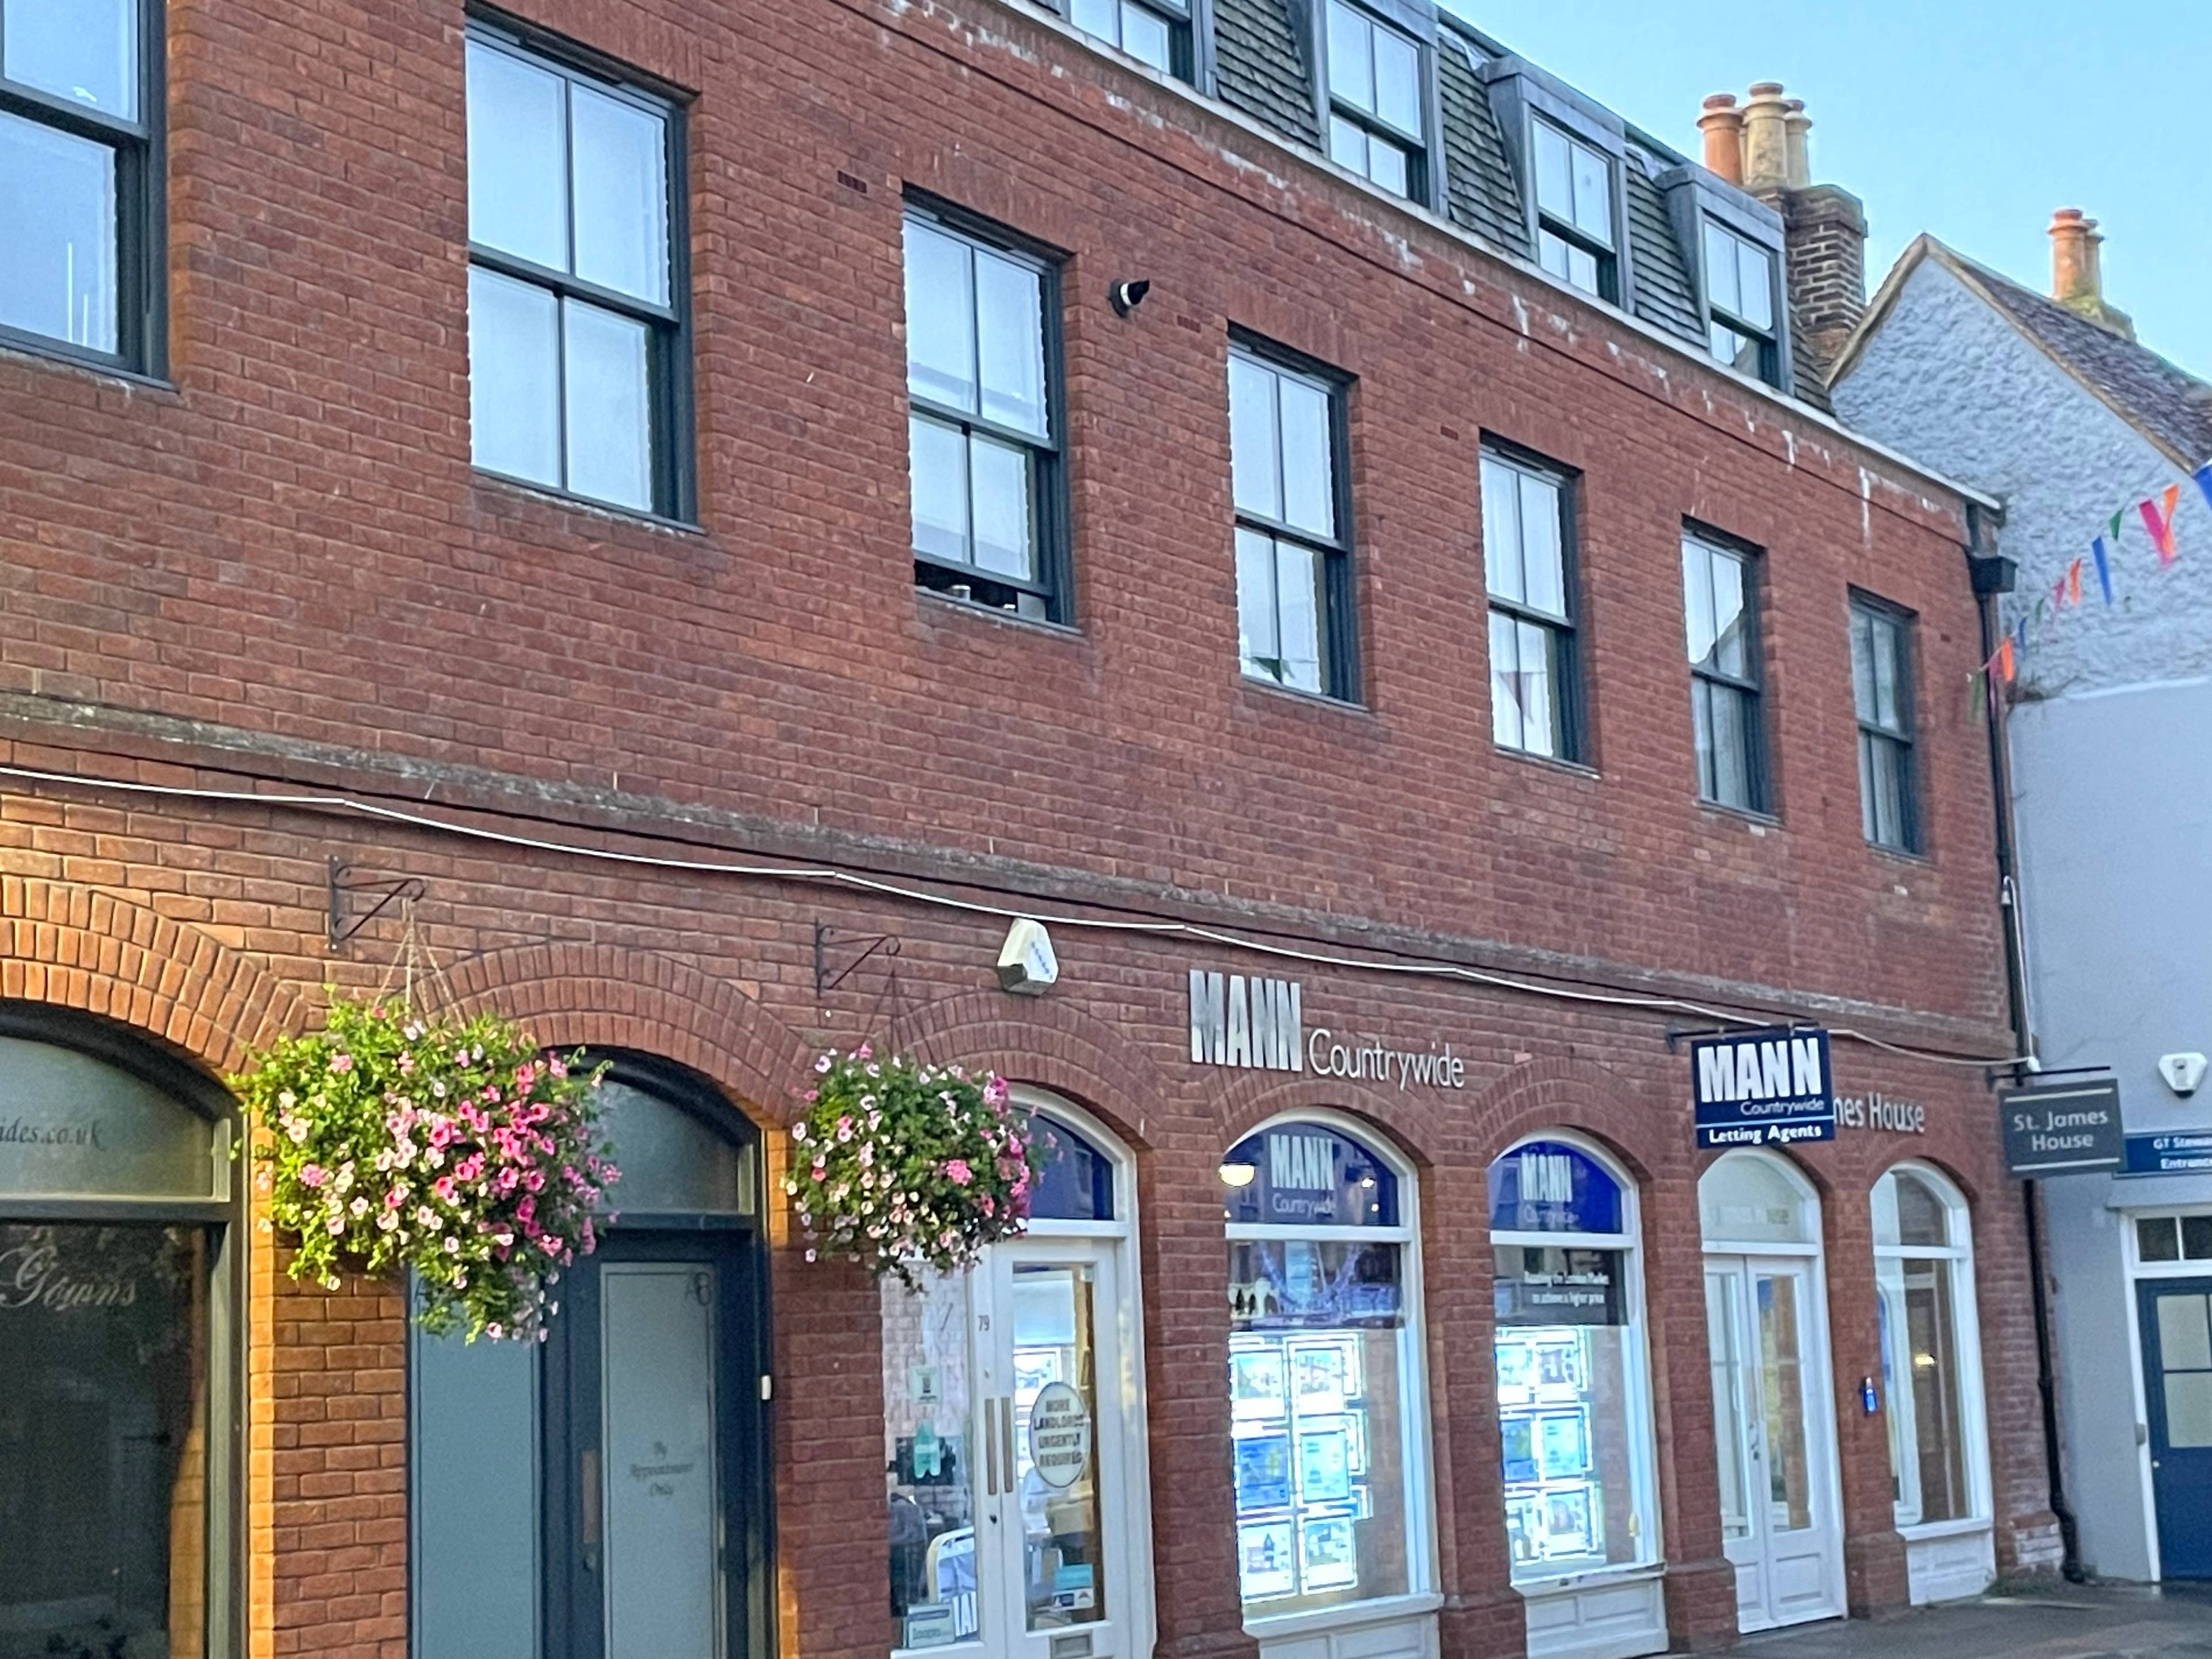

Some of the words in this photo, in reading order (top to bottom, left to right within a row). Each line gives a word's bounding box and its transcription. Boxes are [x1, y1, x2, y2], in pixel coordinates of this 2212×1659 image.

[1189, 969, 1303, 1072] MANN
[1309, 1028, 1465, 1090] Countrywide
[1698, 1037, 1822, 1103] MANN
[1740, 1097, 1825, 1115] Countrywide
[1868, 1092, 1925, 1130] House
[2046, 1109, 2109, 1131] James
[1709, 1127, 1762, 1145] Letting
[1767, 1125, 1823, 1143] Agents
[2031, 1134, 2094, 1152] House
[2153, 1137, 2169, 1150] GT
[1270, 1134, 1335, 1191] MANN
[978, 1315, 990, 1332] 79
